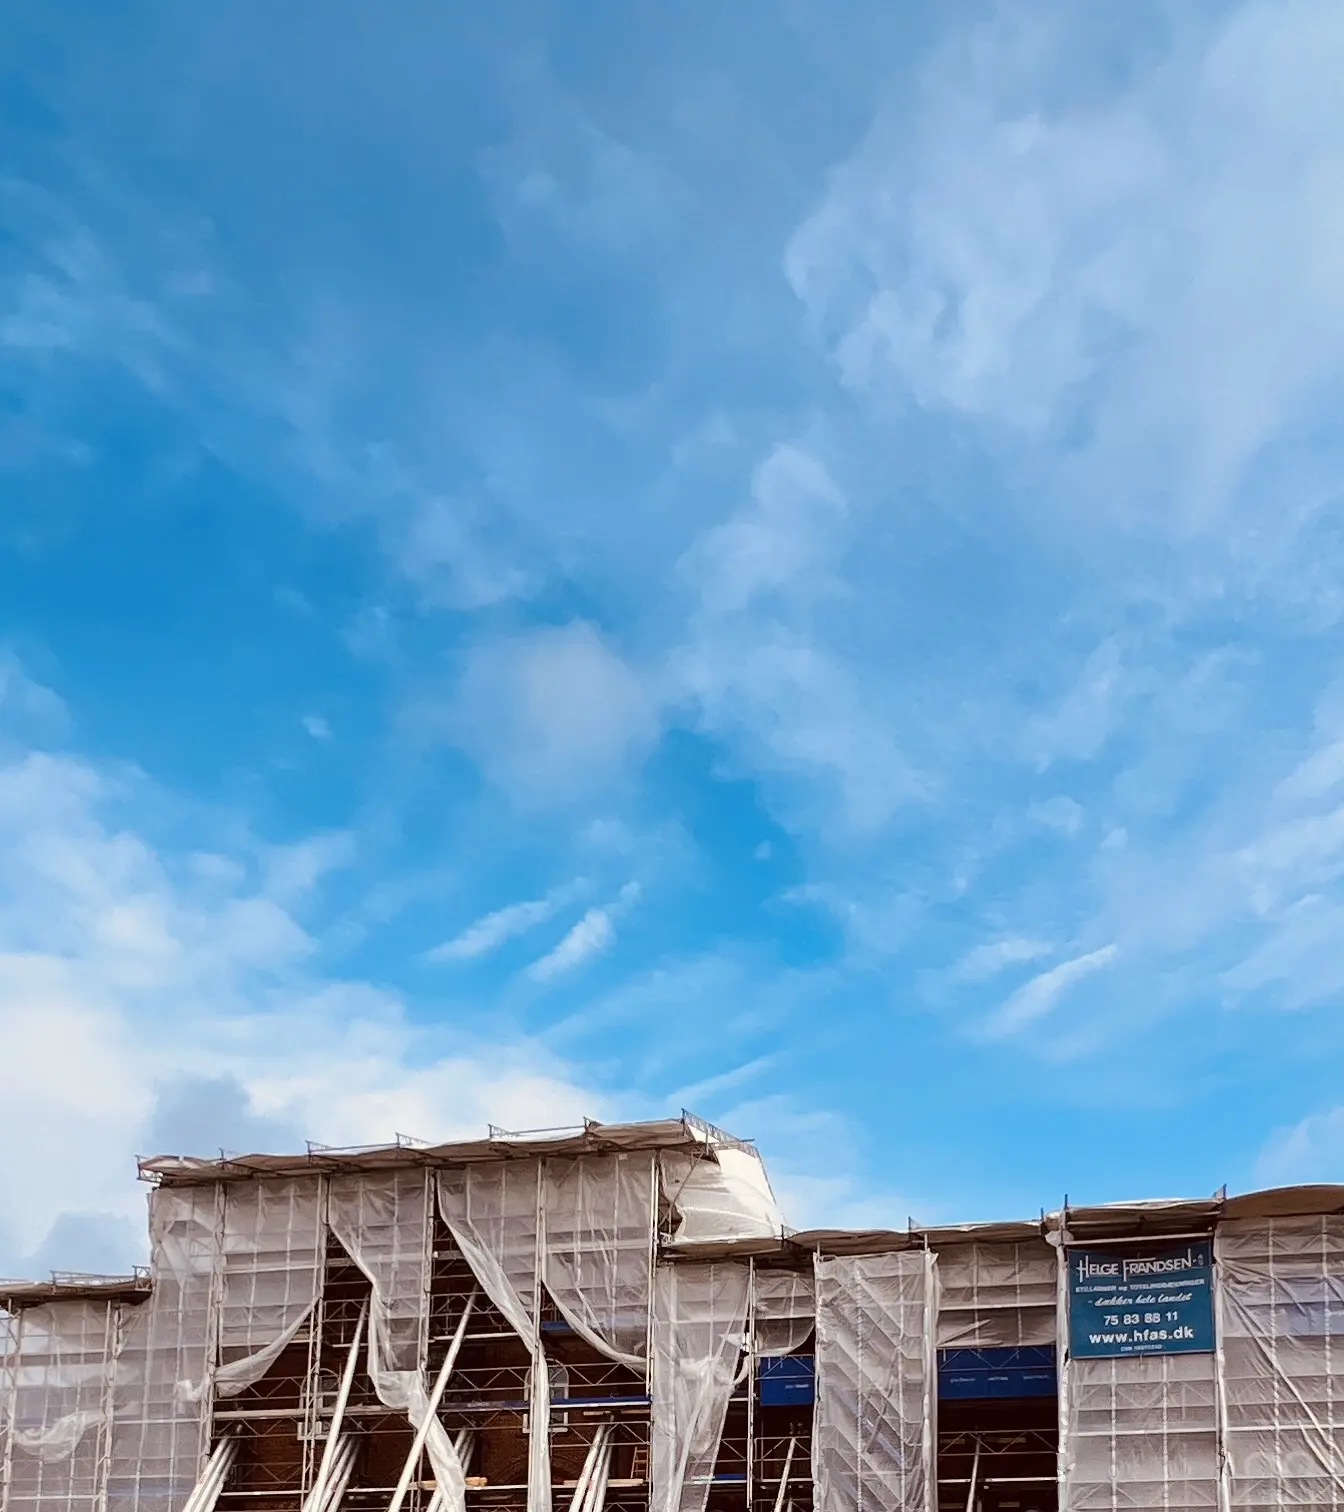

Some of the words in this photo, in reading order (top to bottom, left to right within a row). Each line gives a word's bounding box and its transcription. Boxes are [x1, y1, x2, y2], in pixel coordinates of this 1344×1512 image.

[1076, 1255, 1119, 1283] HELGE
[1122, 1248, 1192, 1283] FRANDSEN
[1094, 1295, 1133, 1307] dækker
[1135, 1294, 1157, 1305] hele
[1158, 1292, 1193, 1303] landet
[1103, 1314, 1119, 1326] 75
[1123, 1313, 1140, 1325] 83
[1144, 1312, 1161, 1323] 88
[1165, 1311, 1178, 1322] 11
[1088, 1325, 1194, 1344] www.hfas.dk
